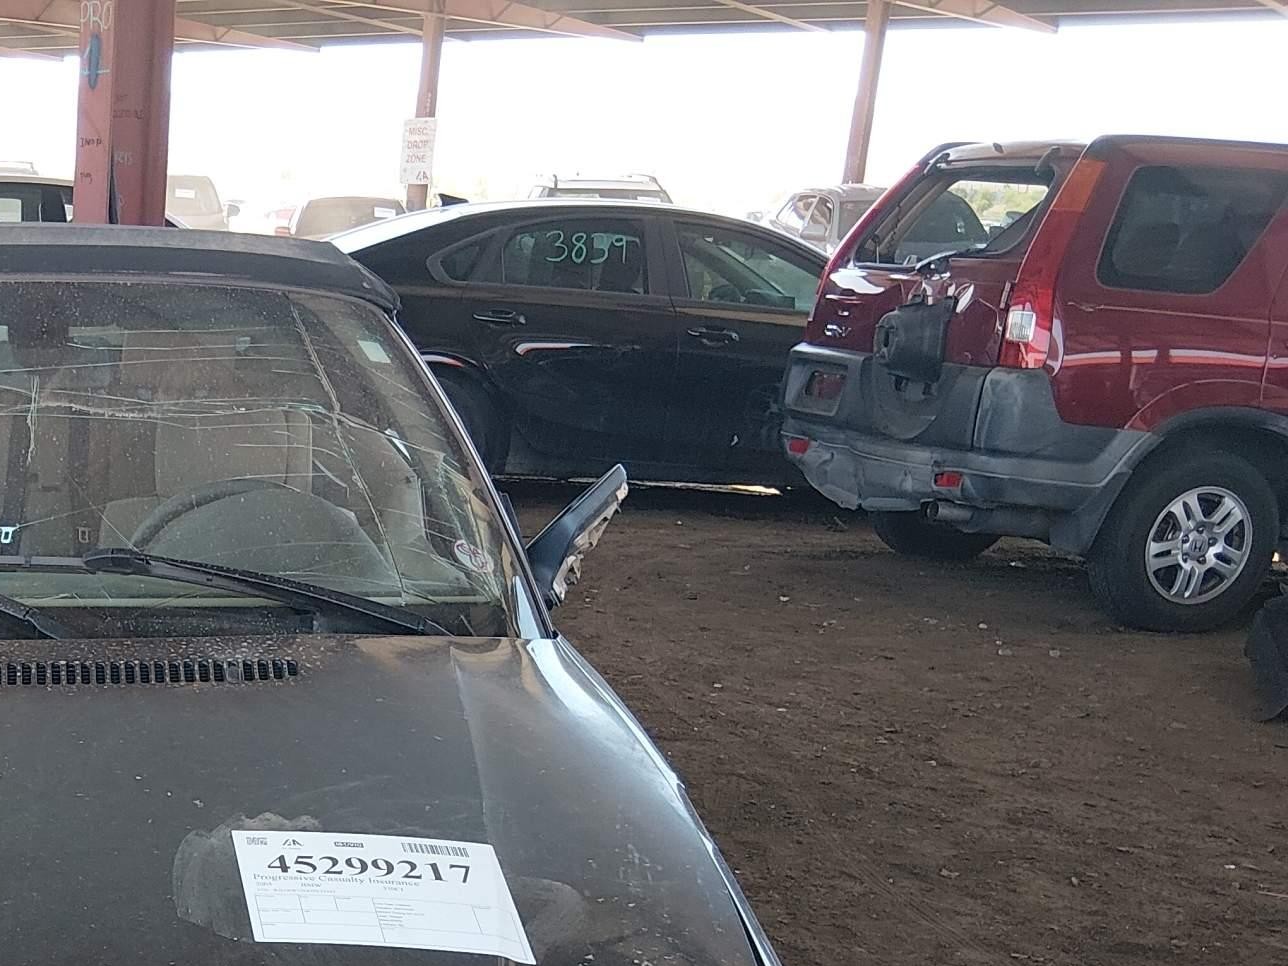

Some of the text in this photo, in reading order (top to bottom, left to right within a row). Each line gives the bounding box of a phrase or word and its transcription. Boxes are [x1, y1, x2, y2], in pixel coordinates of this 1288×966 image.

[253, 873, 420, 887] Progressive Casualty Insurance
[267, 854, 470, 884] 45299217
